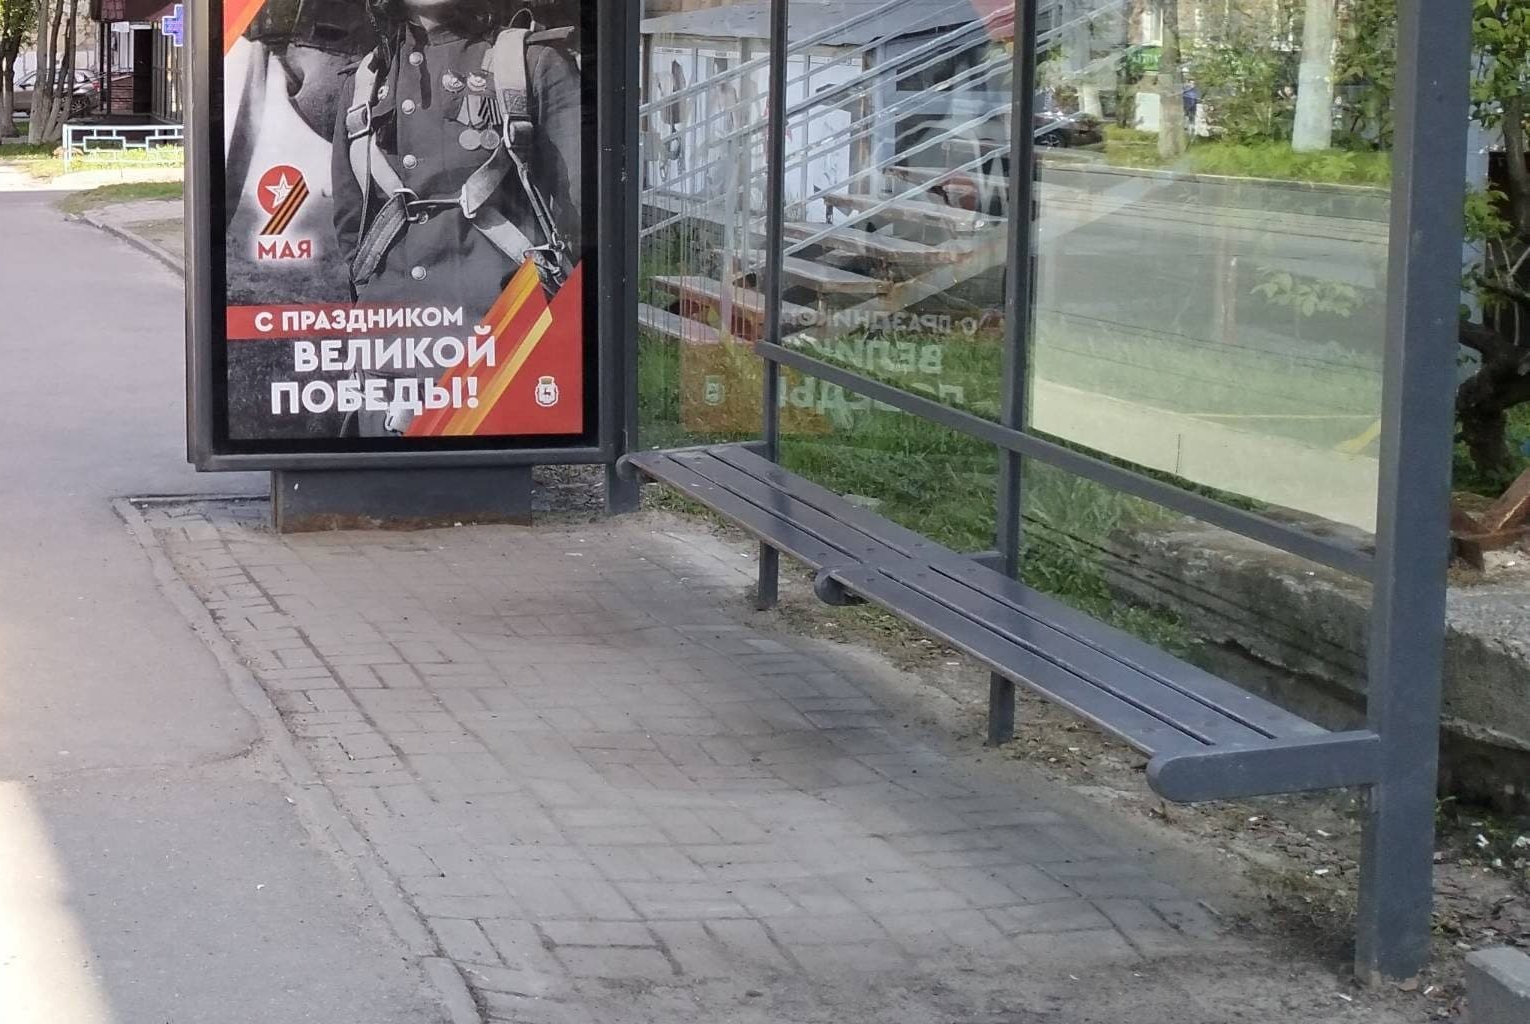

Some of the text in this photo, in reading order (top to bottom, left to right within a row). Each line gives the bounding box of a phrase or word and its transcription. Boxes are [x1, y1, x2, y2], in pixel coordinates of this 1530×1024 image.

[257, 238, 312, 260] МАЯ
[255, 306, 463, 333] С ПРАЗДНИКОМ
[294, 325, 496, 372] ВЕЛИКОЙ
[271, 376, 479, 416] ПОБЕДЫ!
